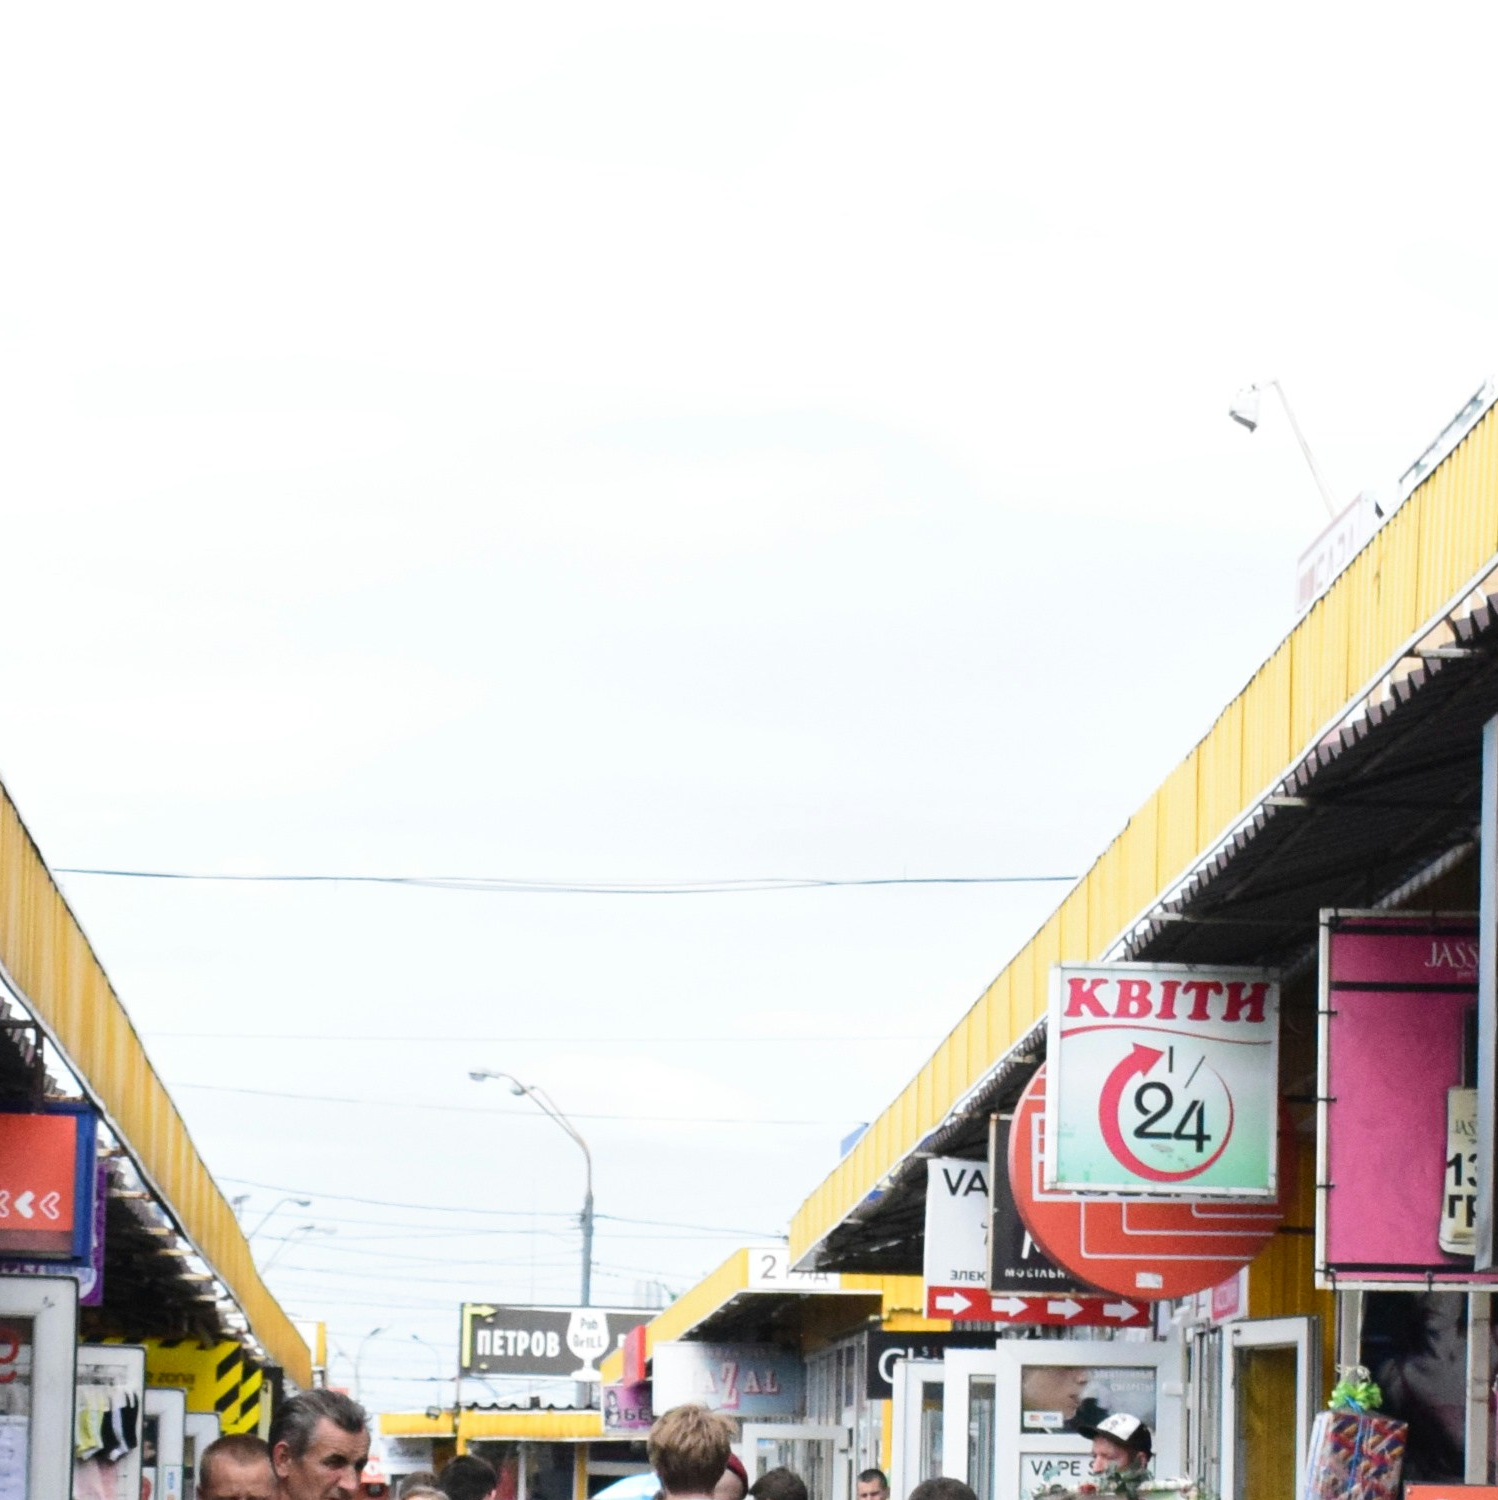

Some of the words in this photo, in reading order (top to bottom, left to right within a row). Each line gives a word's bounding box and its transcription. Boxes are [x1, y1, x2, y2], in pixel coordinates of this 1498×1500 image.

[1063, 977, 1271, 1023] КВІТИ
[1134, 1081, 1212, 1153] 24
[476, 1328, 561, 1358] ПЕТРОВ
